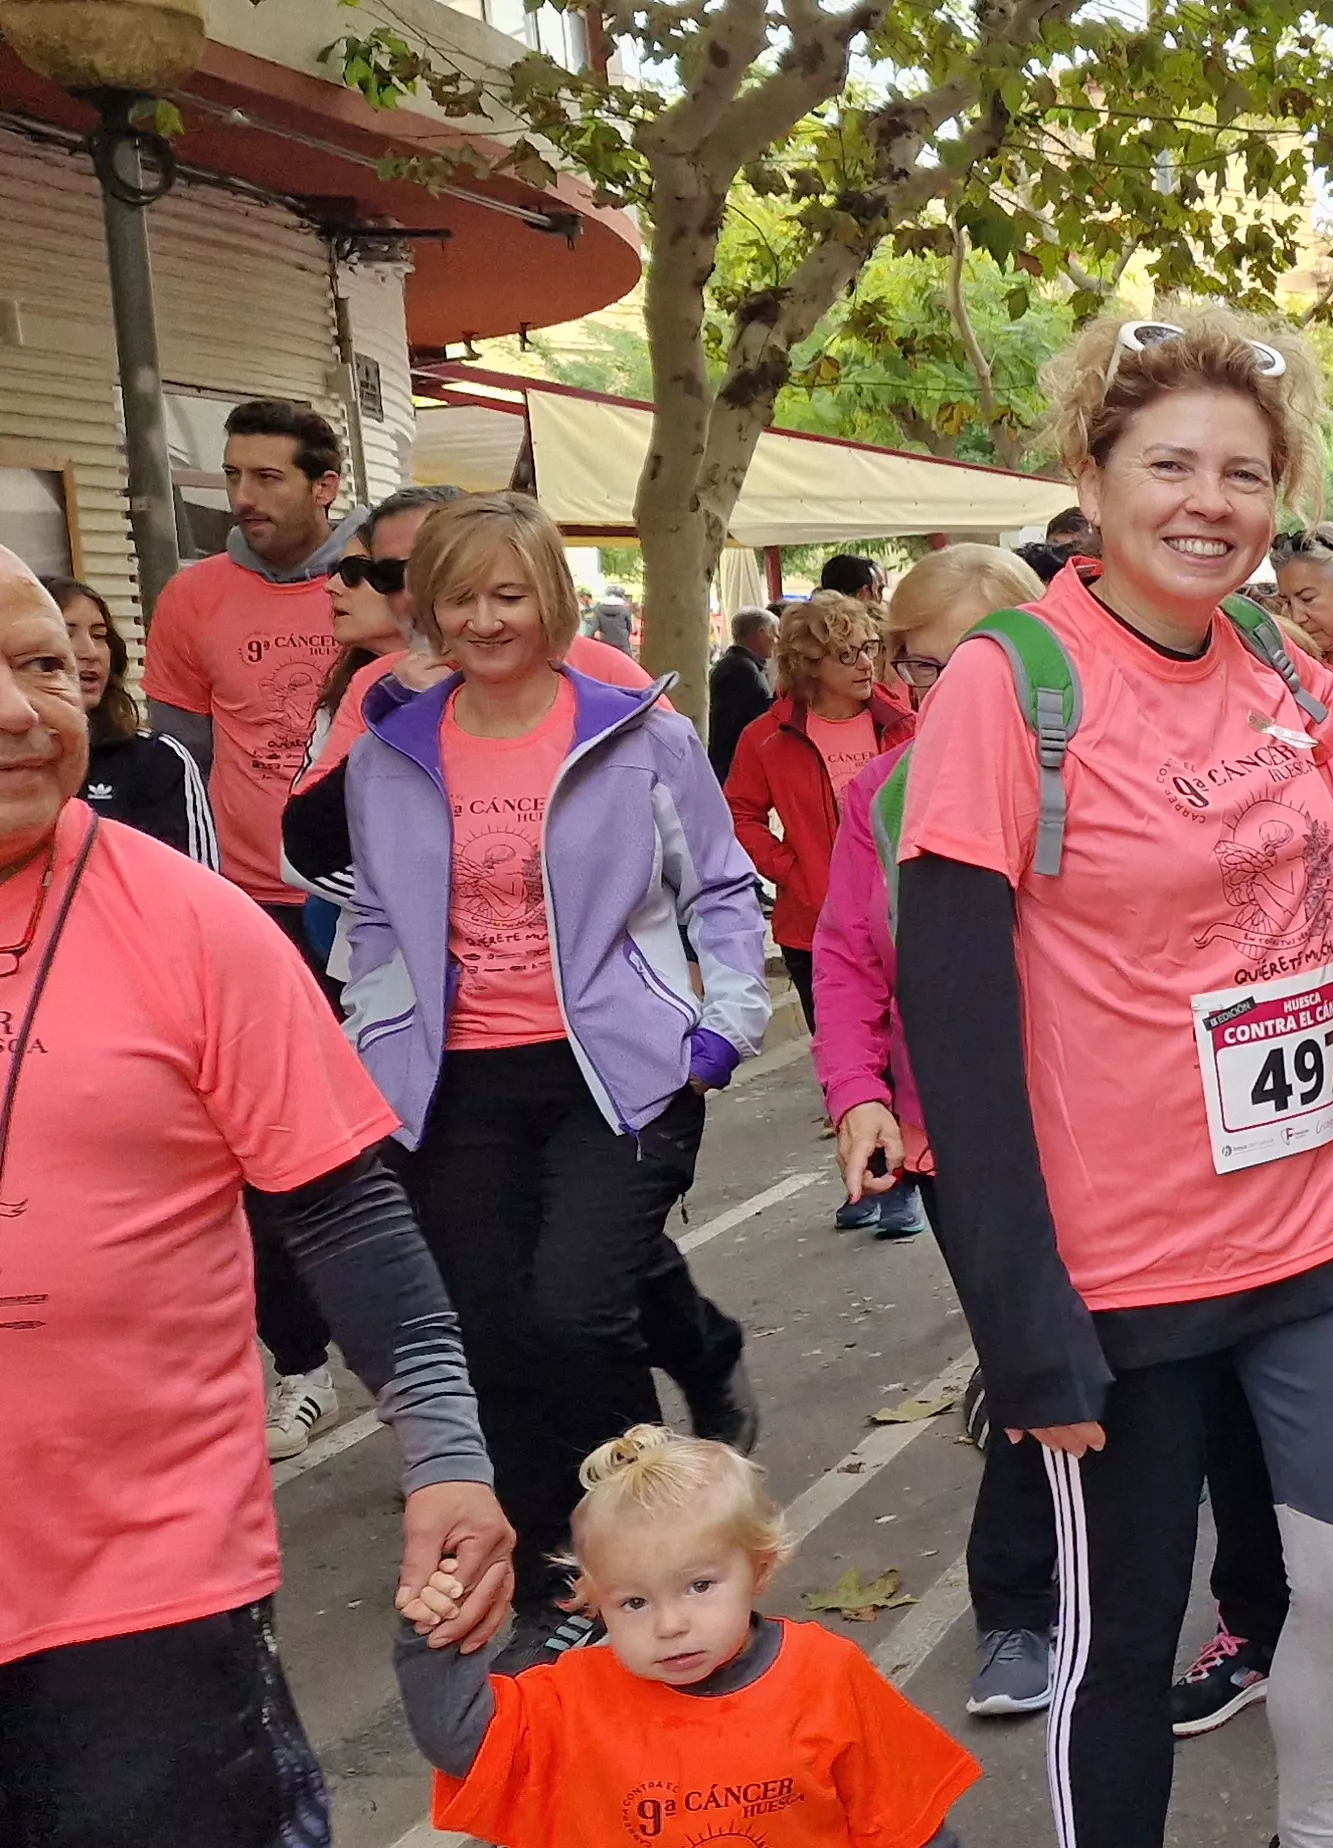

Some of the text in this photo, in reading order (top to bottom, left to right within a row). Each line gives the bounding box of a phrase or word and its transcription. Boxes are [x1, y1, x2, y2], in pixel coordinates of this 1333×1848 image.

[1172, 744, 1297, 808] 9ª CÁNCER
[1268, 757, 1317, 783] HUESCA
[469, 796, 545, 815] CÁNCE
[1234, 951, 1302, 985] QUIÉRETE
[1283, 991, 1322, 1014] HUESCA
[1223, 1015, 1297, 1044] CONTRA
[1299, 1012, 1315, 1029] EL
[637, 1777, 795, 1837] 9ª CÁNCER
[742, 1793, 806, 1819] HUESCA
